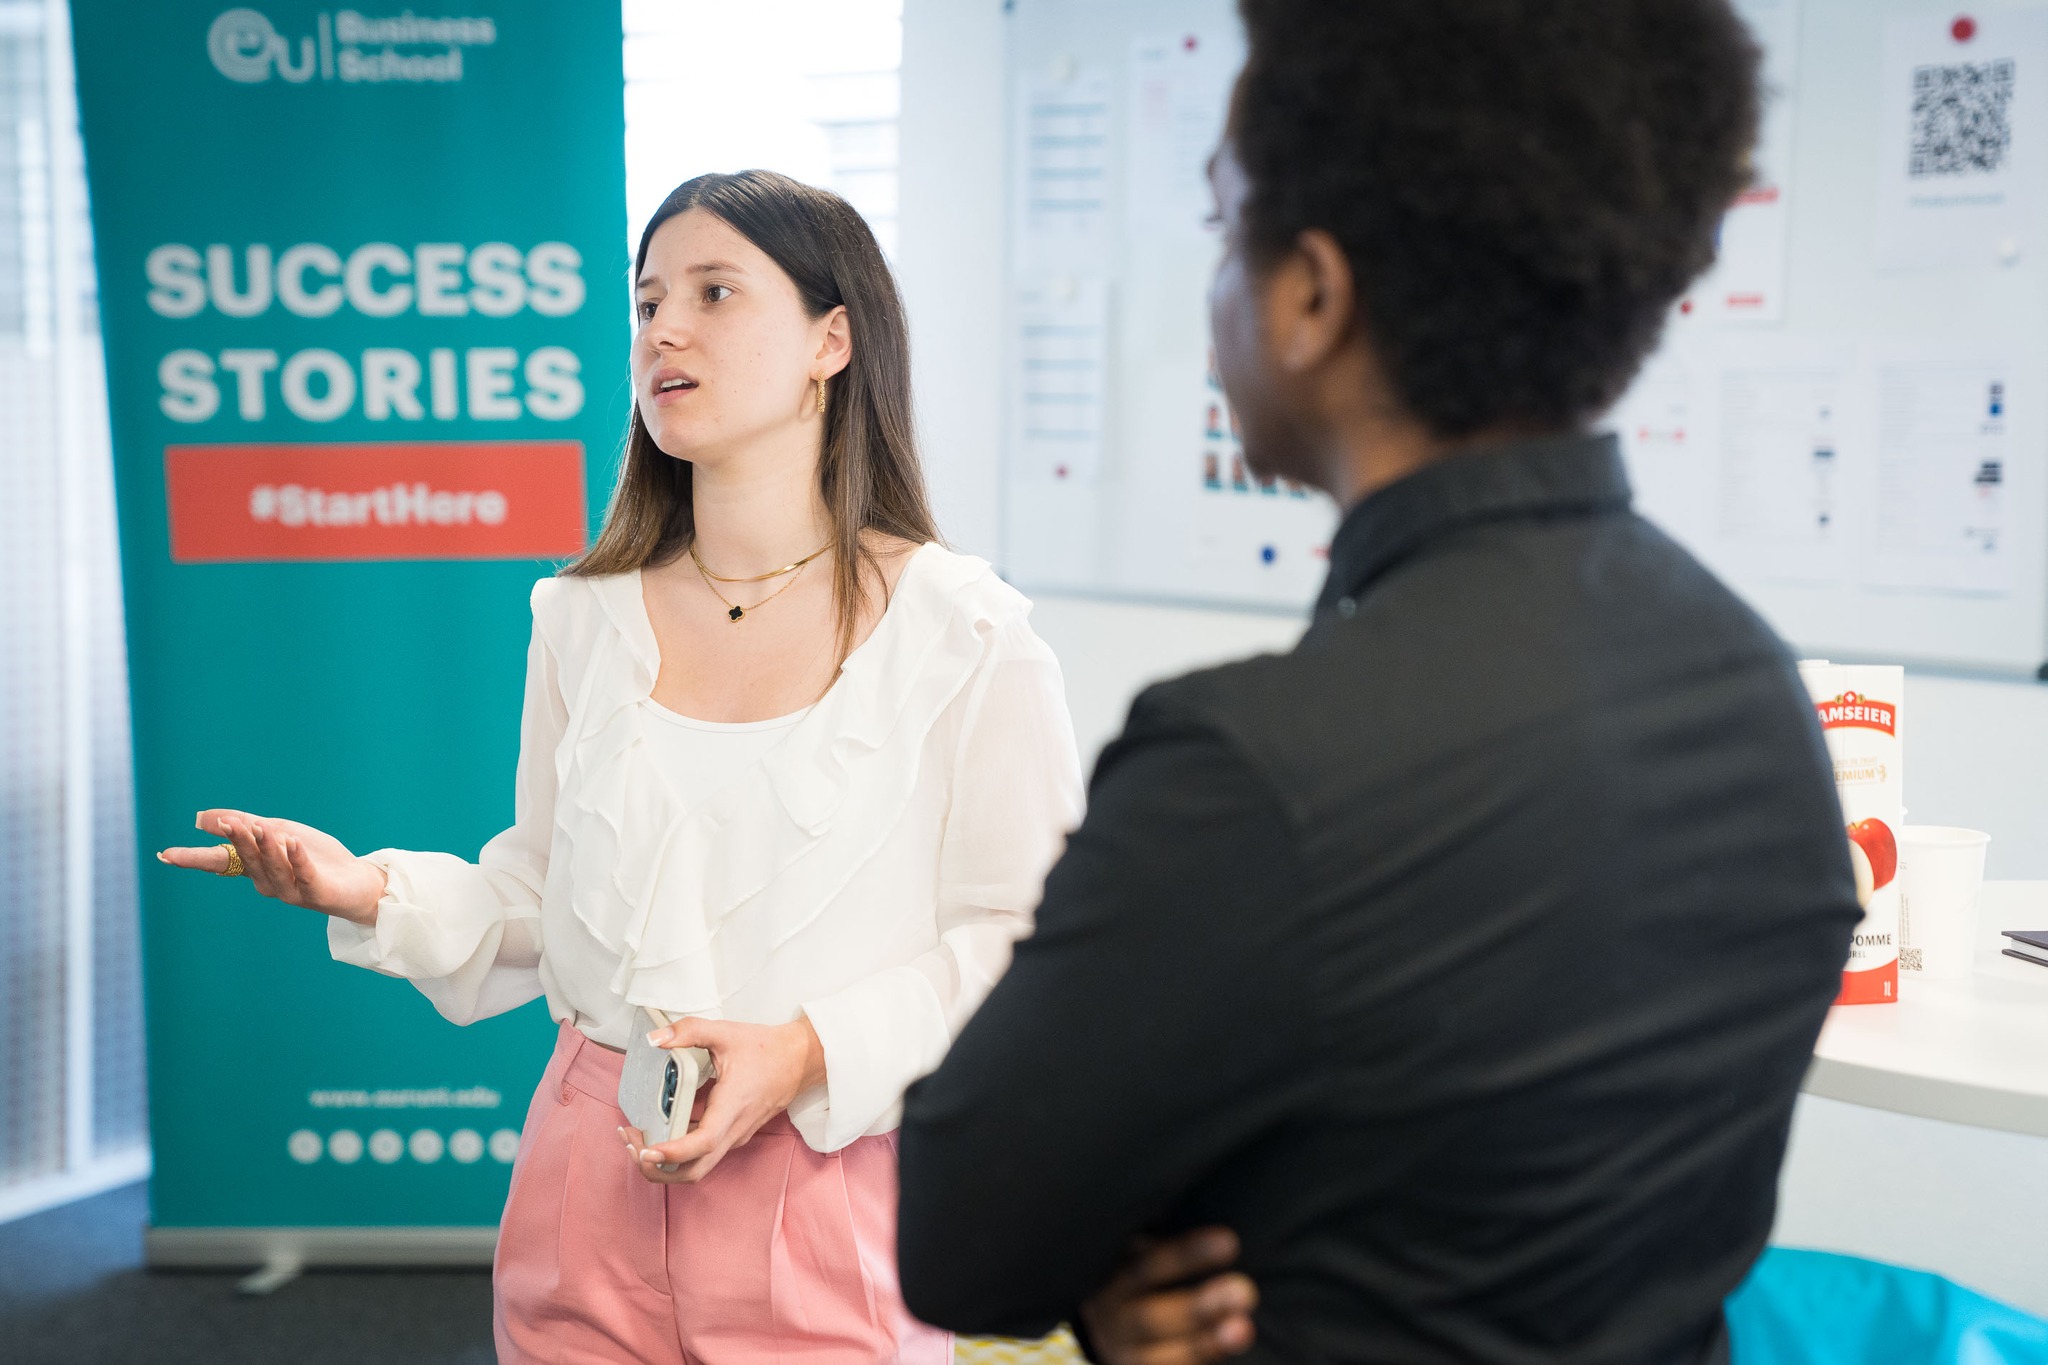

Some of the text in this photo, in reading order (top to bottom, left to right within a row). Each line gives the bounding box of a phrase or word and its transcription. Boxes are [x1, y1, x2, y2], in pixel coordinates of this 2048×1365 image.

[335, 9, 497, 46] Business
[338, 47, 463, 83] School
[145, 242, 585, 318] SUCCESS
[158, 346, 585, 422] STORIES
[249, 483, 507, 527] #StartHere
[1818, 706, 1891, 726] AMSEIER
[1834, 768, 1874, 781] EMIUM
